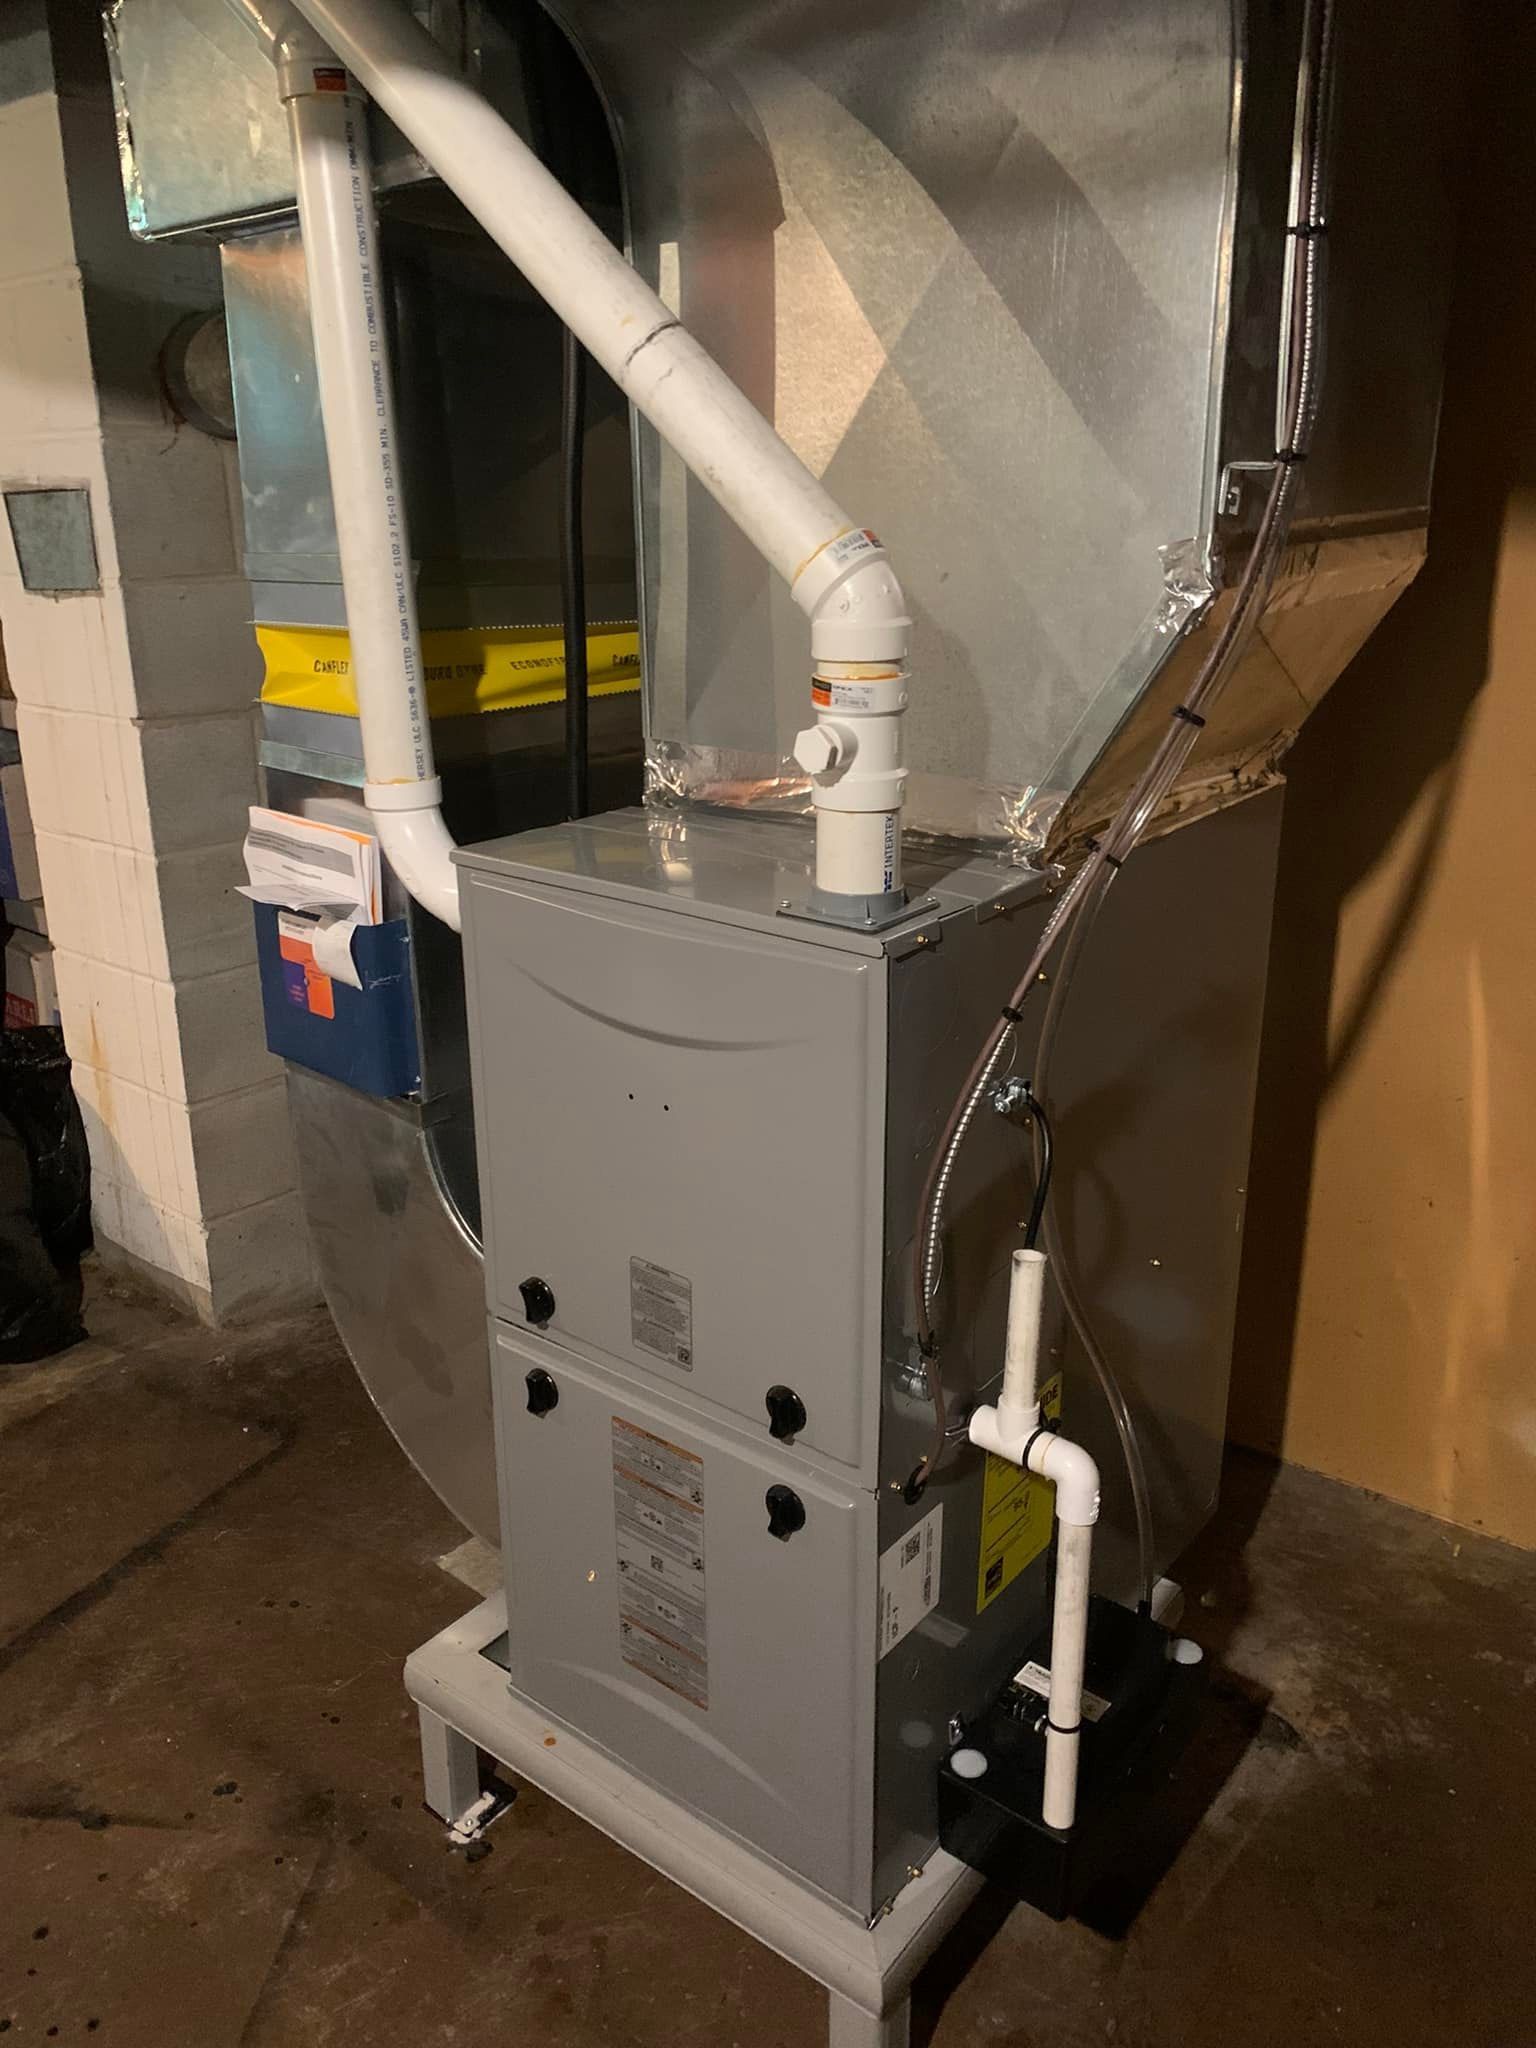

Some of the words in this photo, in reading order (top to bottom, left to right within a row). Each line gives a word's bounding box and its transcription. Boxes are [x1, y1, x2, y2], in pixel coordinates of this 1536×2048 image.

[351, 176, 369, 257] CONSTRUCTION
[360, 263, 377, 334] COMBUSTIBLE
[369, 341, 379, 353] TO
[371, 360, 386, 417] CLEARANCE
[380, 424, 389, 448] MIN.
[395, 573, 407, 613] CAN/ULC
[403, 647, 415, 681] LISTED
[884, 815, 894, 869] INTERTEK
